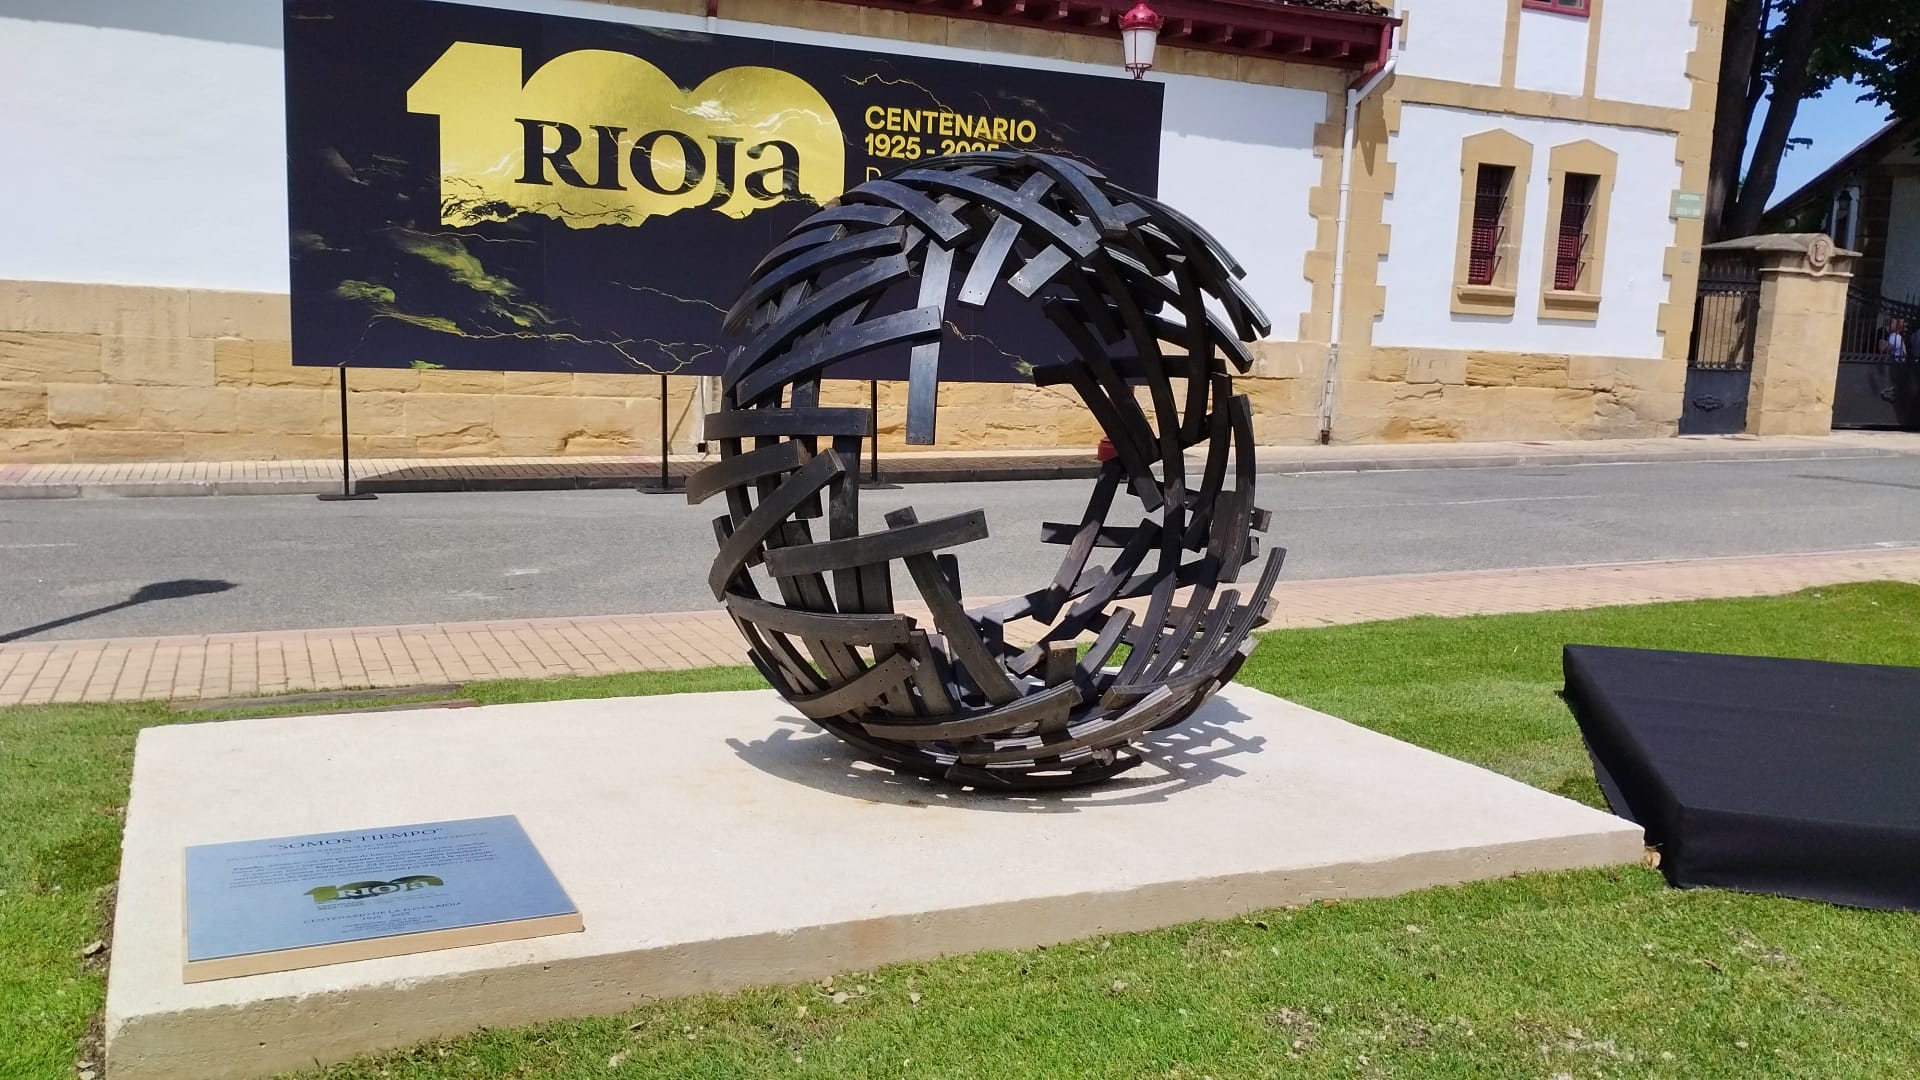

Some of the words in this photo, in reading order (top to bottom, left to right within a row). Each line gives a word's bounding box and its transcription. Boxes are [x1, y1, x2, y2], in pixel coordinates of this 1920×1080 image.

[407, 41, 846, 230] 100
[865, 105, 1037, 143] CENTENARIO
[864, 132, 921, 160] 1925
